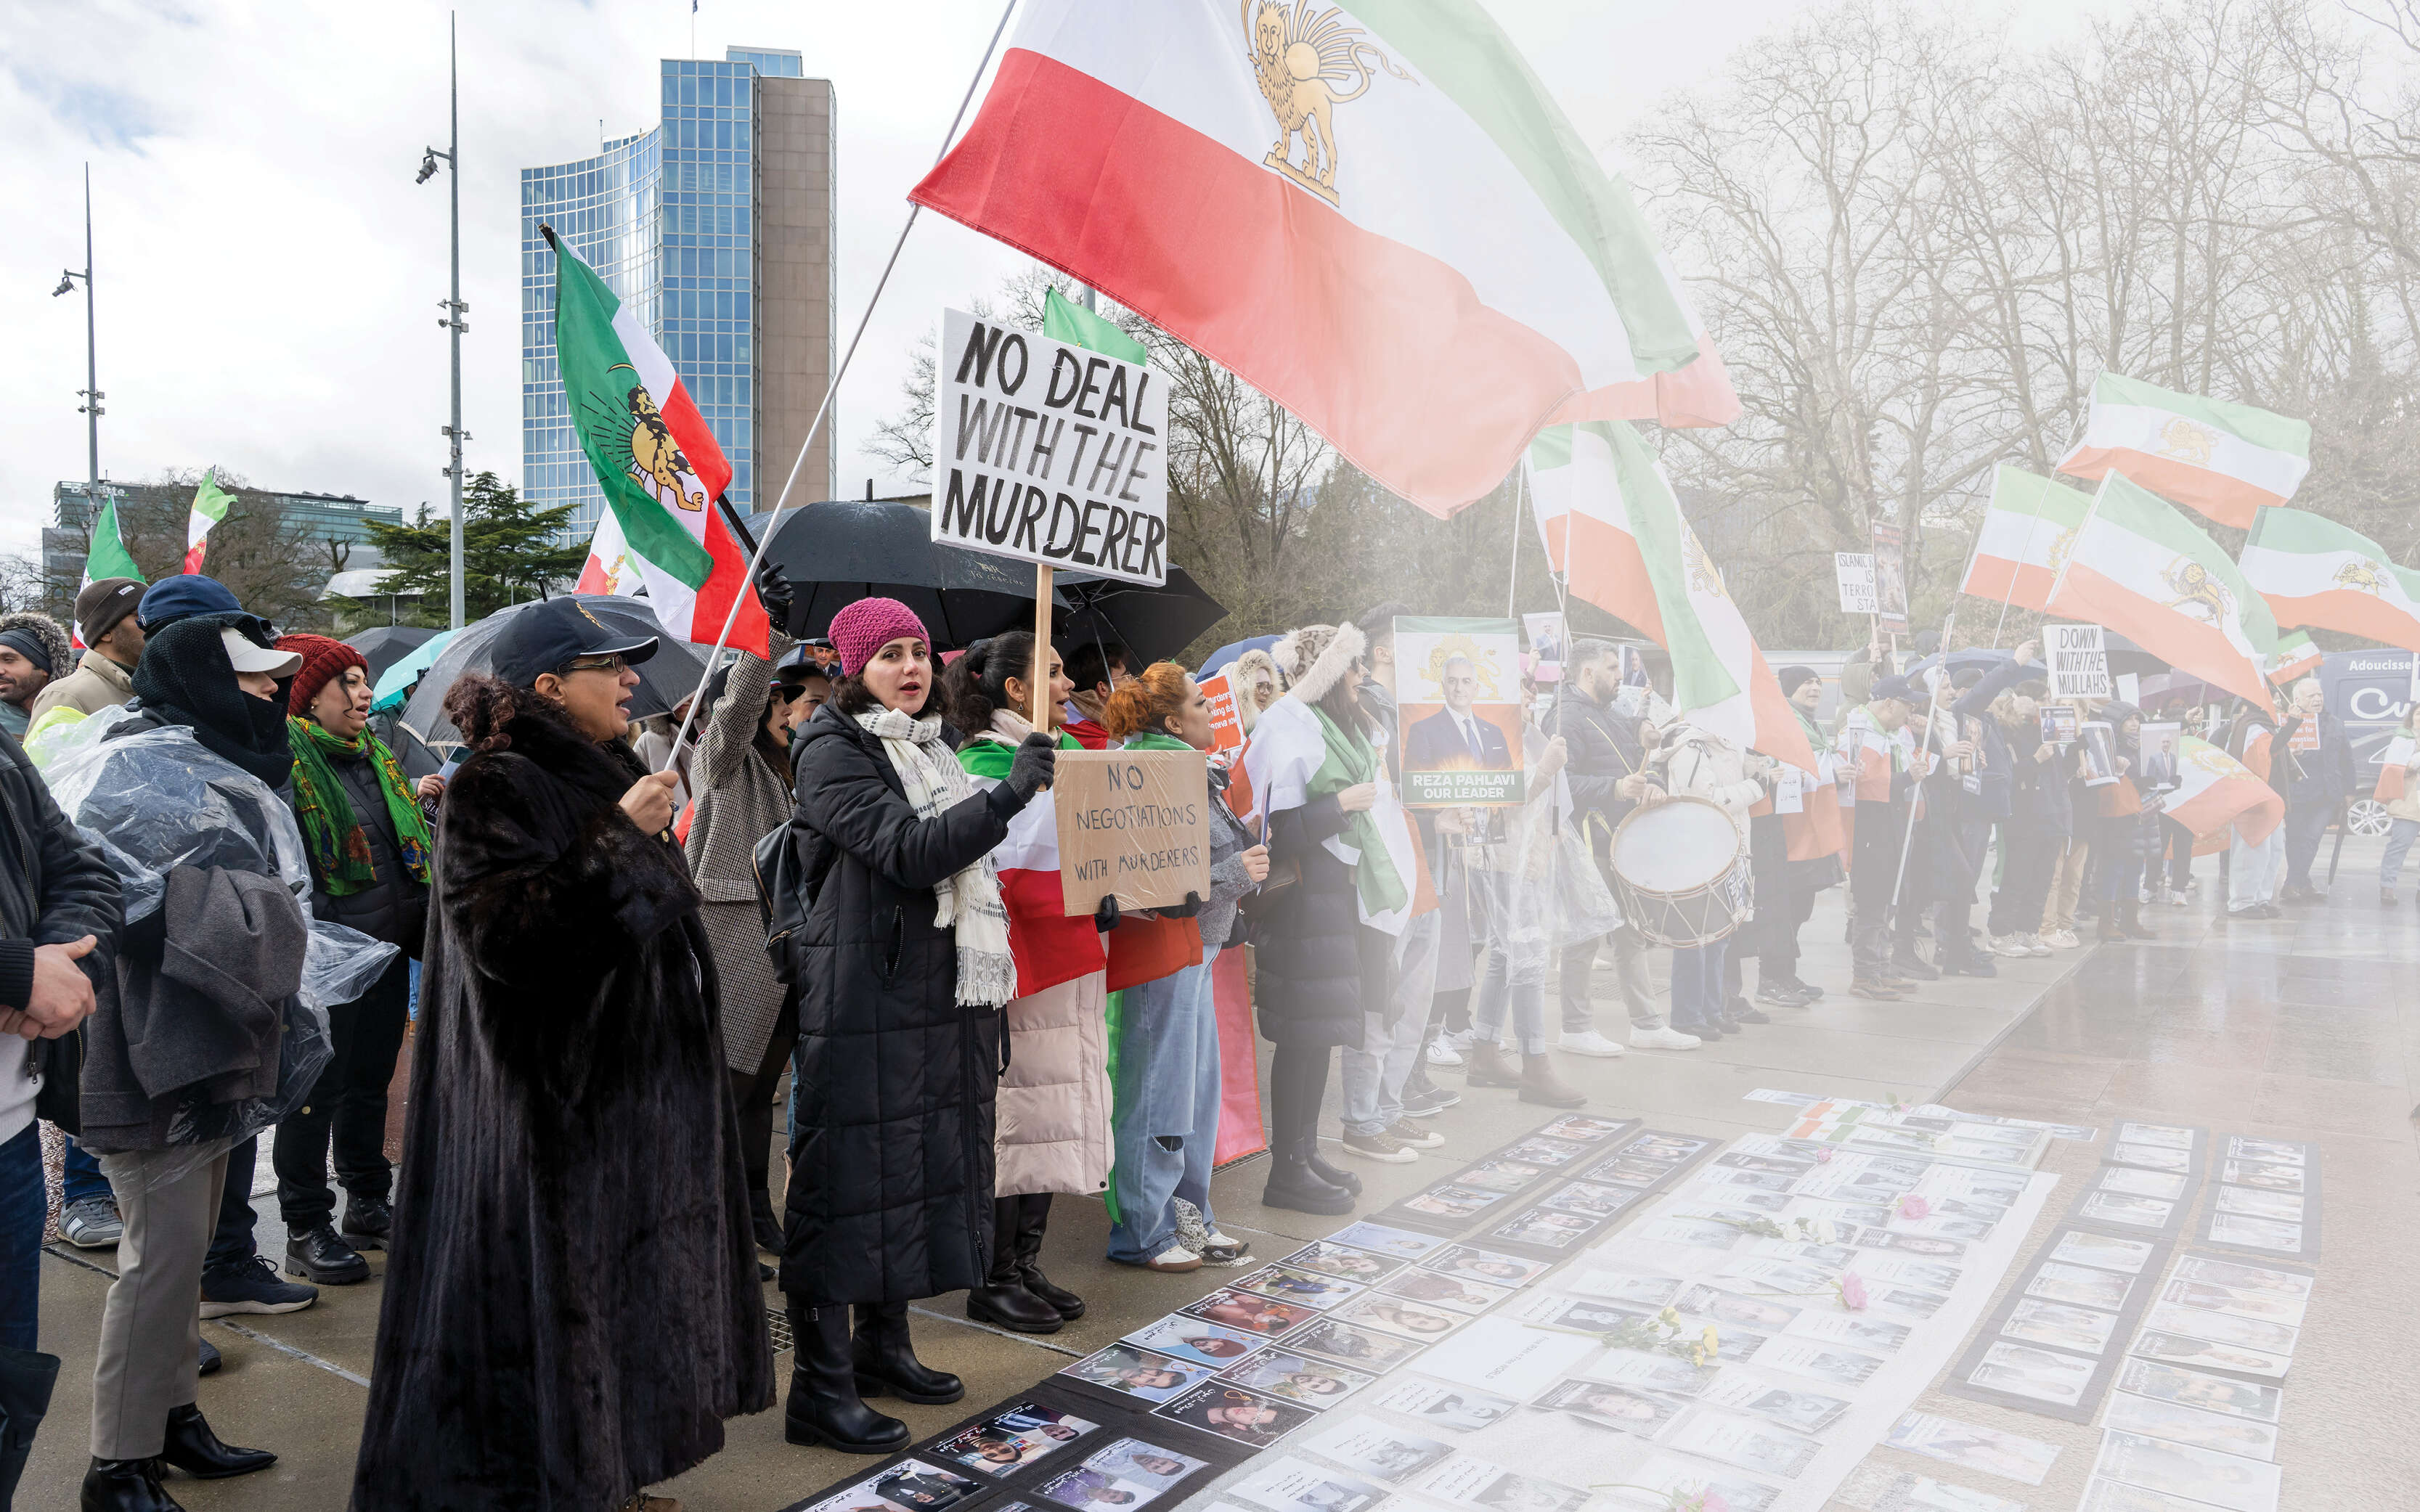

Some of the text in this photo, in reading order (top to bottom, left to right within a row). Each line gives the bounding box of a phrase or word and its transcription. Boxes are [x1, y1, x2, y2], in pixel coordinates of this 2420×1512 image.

[955, 322, 1156, 436] NO DEAL
[956, 394, 1157, 502] WITH THE
[940, 467, 1165, 579] MURDERER
[1838, 555, 1867, 568] ISLAMIC
[1865, 570, 1874, 583] IS
[1842, 584, 1873, 597] TERRO
[1857, 598, 1877, 610] STA
[2060, 628, 2097, 649] DOWN
[2056, 651, 2106, 671] WITH THE
[2349, 659, 2412, 671] Adoucisse
[2058, 674, 2107, 695] MULLAHS
[1107, 764, 1144, 792] NO
[1412, 775, 1515, 786] REZA PAHLAVI
[1423, 787, 1504, 798] OUR LEADER
[1076, 804, 1197, 830] NEGOTIATIONS
[1075, 846, 1198, 881] WITH MURDERERS
